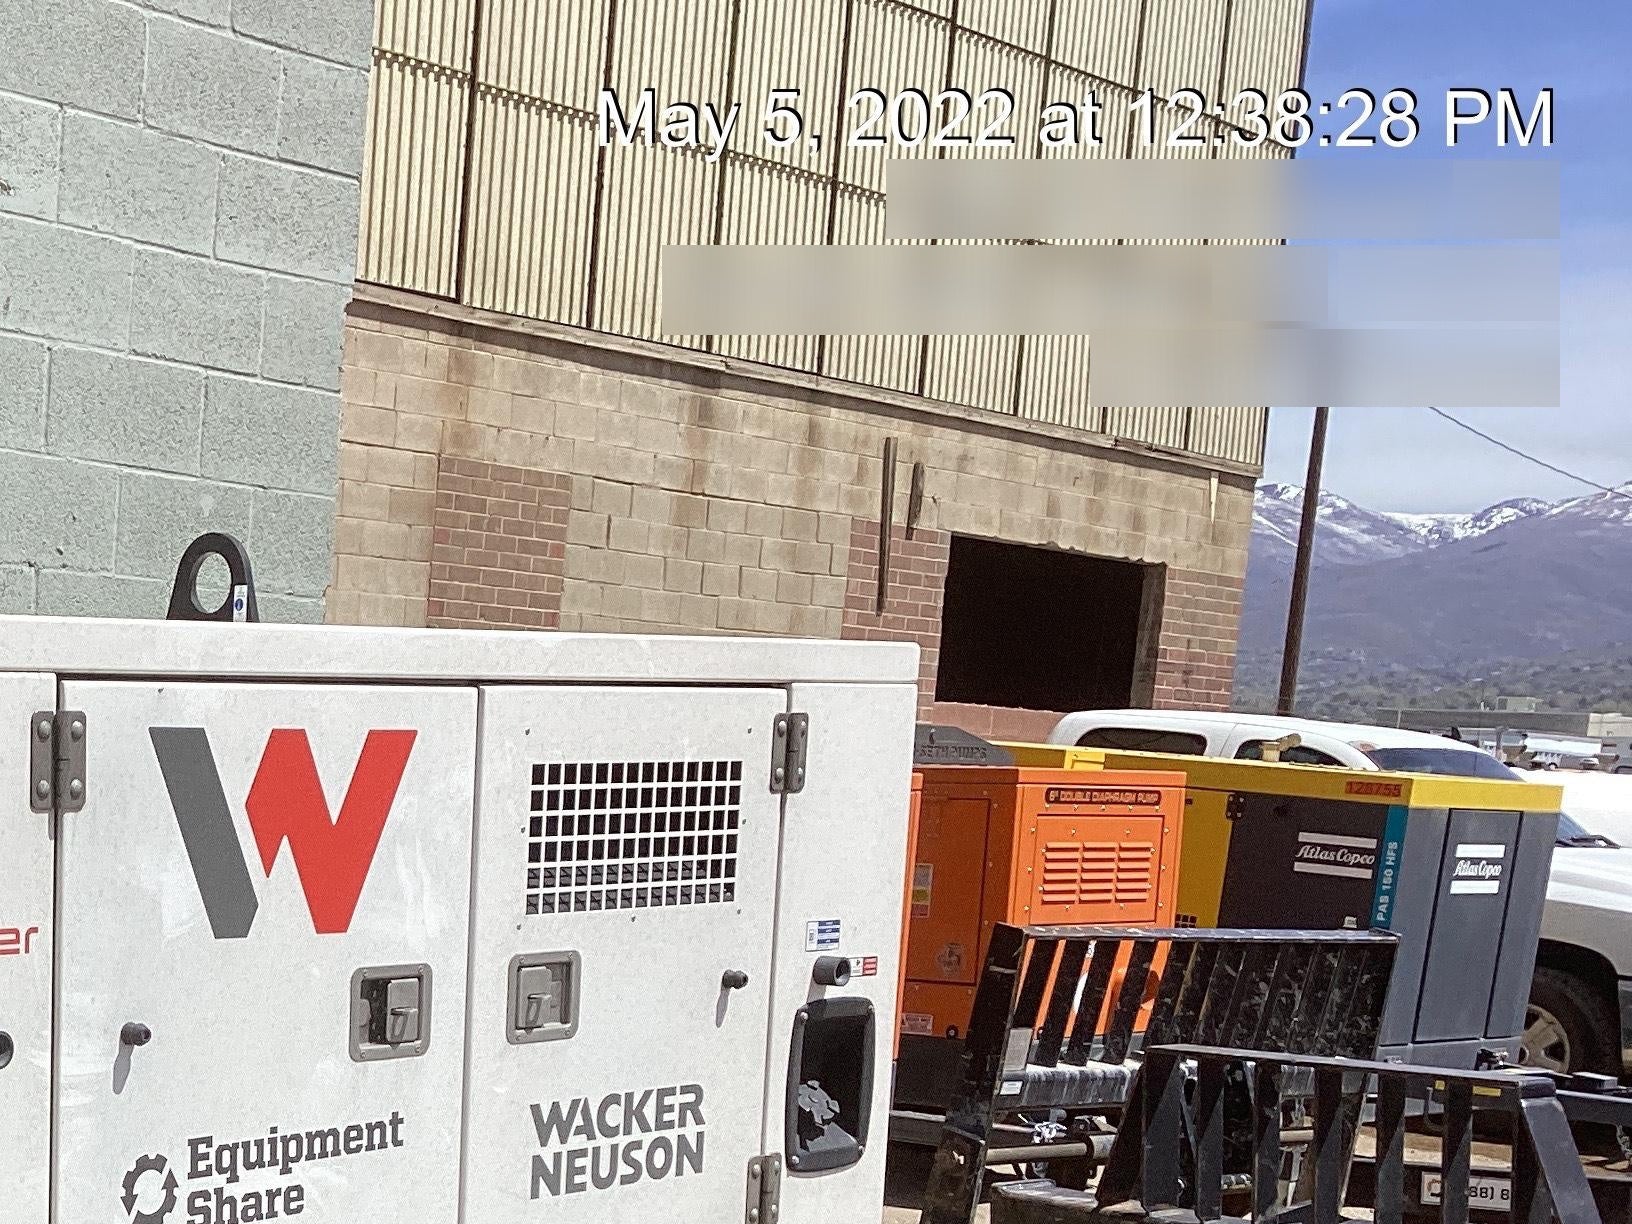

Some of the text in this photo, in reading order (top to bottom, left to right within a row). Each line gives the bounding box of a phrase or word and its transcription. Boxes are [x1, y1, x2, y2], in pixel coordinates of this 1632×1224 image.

[186, 1111, 404, 1184] Equipment
[529, 1083, 706, 1148] WACKER
[530, 1130, 705, 1200] NEUSON
